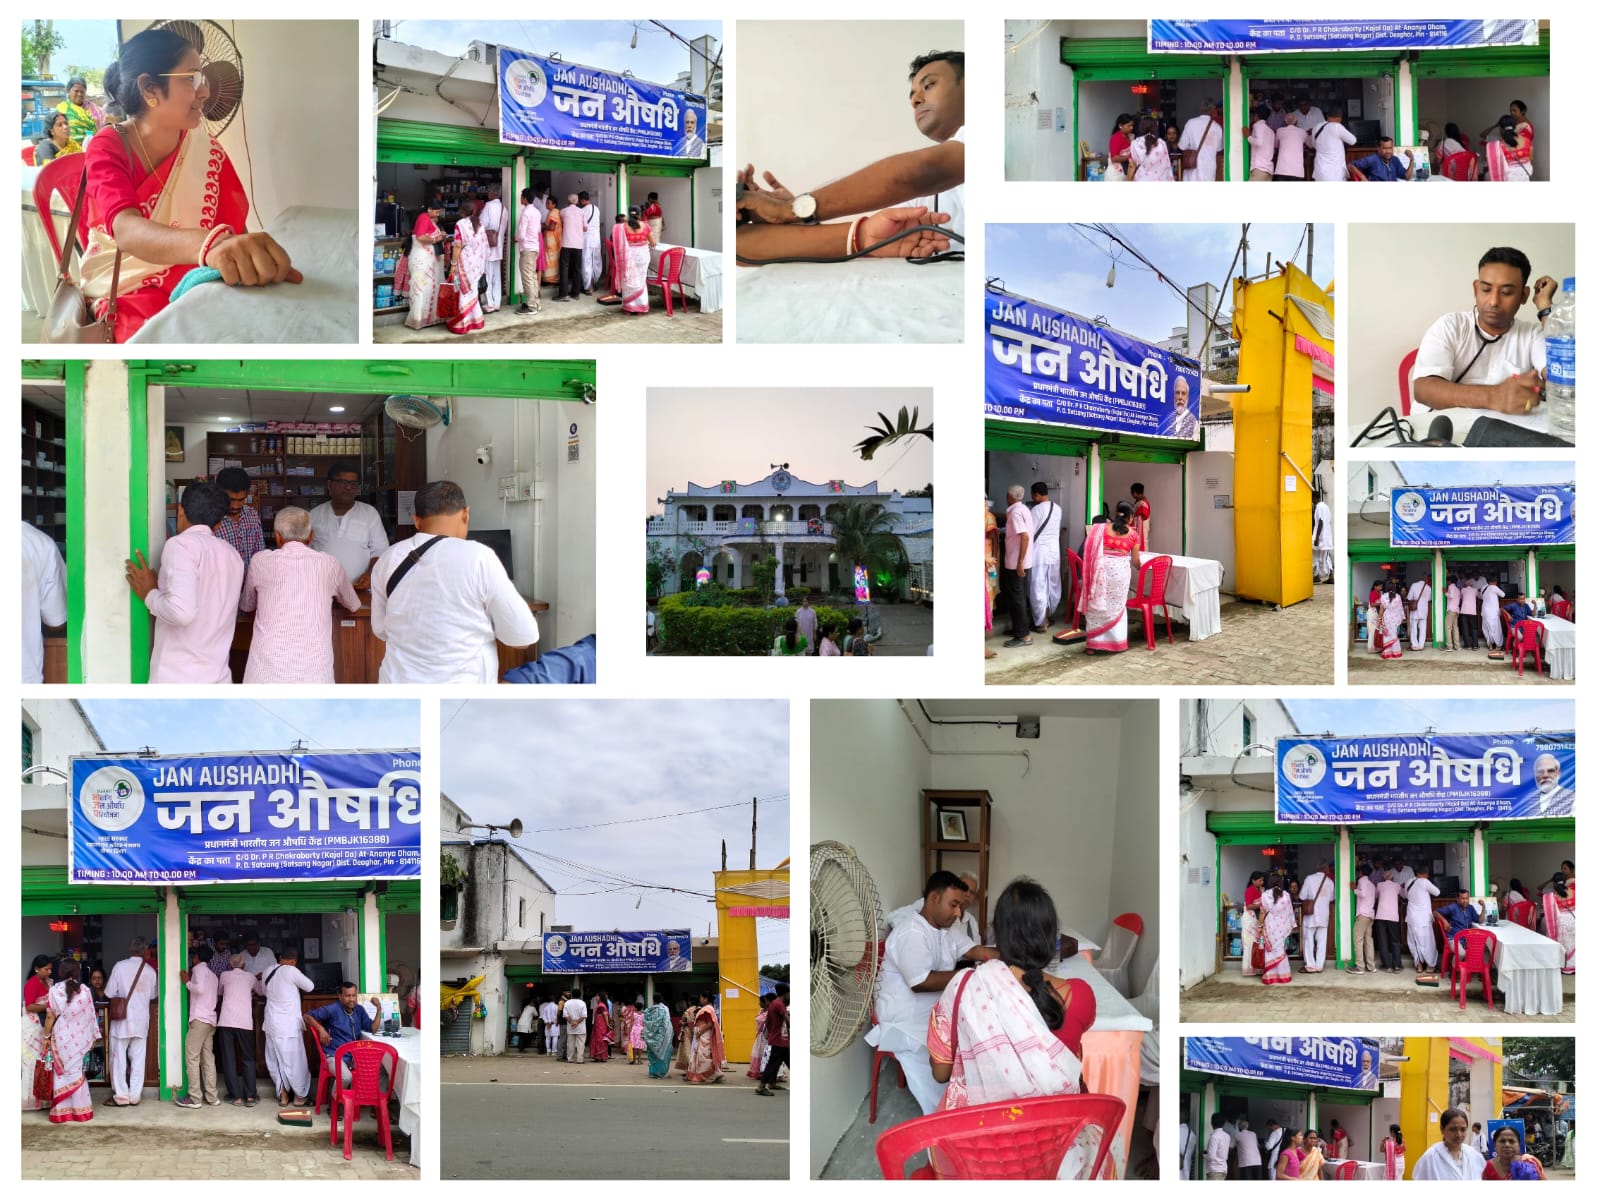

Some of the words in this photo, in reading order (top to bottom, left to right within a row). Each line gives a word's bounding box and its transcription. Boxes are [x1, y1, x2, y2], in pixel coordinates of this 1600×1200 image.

[553, 68, 576, 85] JAN
[579, 73, 628, 96] AUSHADHI
[552, 85, 607, 121] जन
[611, 87, 680, 131] औषधि
[992, 301, 1027, 328] JAN
[1031, 312, 1100, 350] AUSHADHI
[990, 323, 1072, 382] जन
[1079, 340, 1168, 403] औषधि
[1013, 407, 1025, 416] PM
[1429, 491, 1449, 502] JAN
[1451, 490, 1499, 502] AUSHADHI
[1430, 503, 1477, 524] जन
[1483, 494, 1563, 523] औषधि
[1331, 744, 1359, 758] JAN
[1362, 742, 1431, 758] AUSHADHI
[153, 766, 193, 787] JAN
[199, 763, 299, 786] AUSHADHI
[1331, 760, 1400, 790] जन
[1408, 746, 1524, 788] औषधि
[153, 790, 255, 834] जन
[269, 838, 280, 847] जन
[76, 869, 105, 878] TIMING
[149, 870, 159, 879] TO
[184, 869, 196, 879] PM
[569, 935, 583, 943] JAN
[584, 935, 618, 943] AUSHADHI
[569, 943, 602, 958] जन
[606, 936, 662, 957] औषधि
